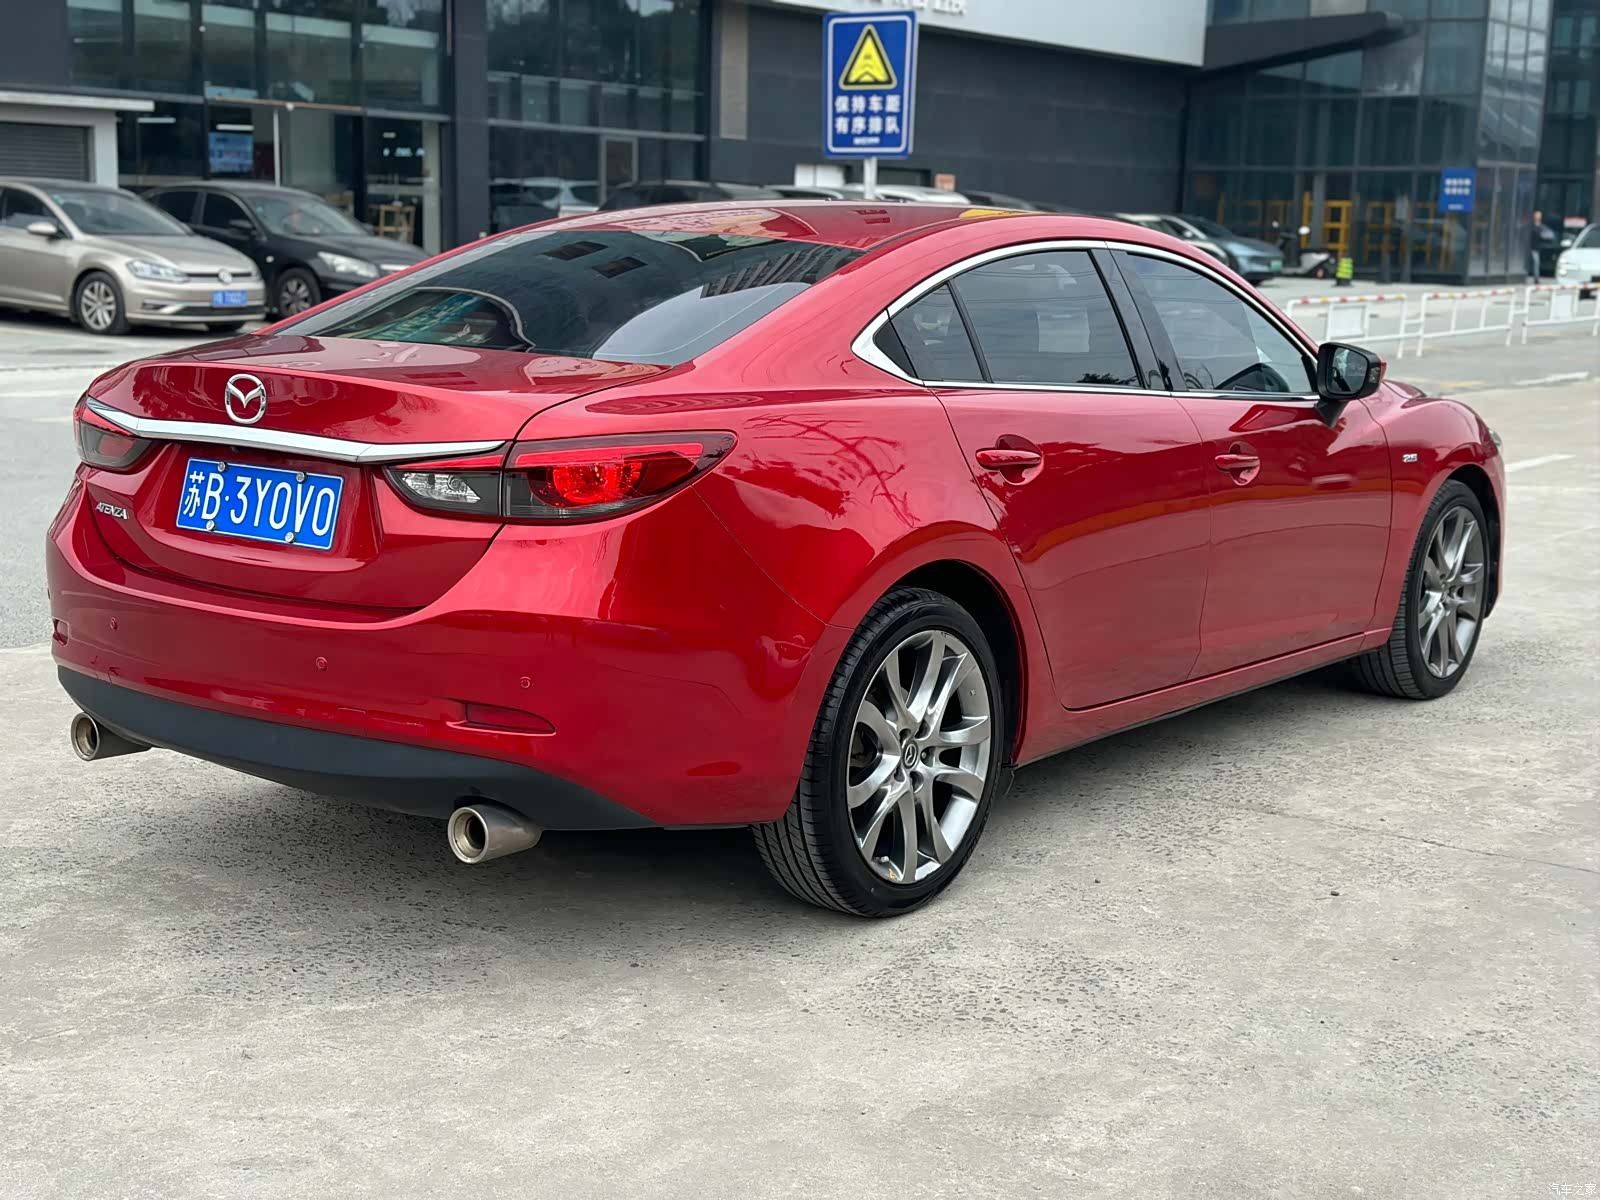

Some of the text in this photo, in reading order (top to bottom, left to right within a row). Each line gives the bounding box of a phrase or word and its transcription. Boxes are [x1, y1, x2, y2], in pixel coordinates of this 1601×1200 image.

[834, 94, 901, 114] 保持车距
[834, 115, 901, 134] 有序排队
[96, 502, 128, 520] ATENZA
